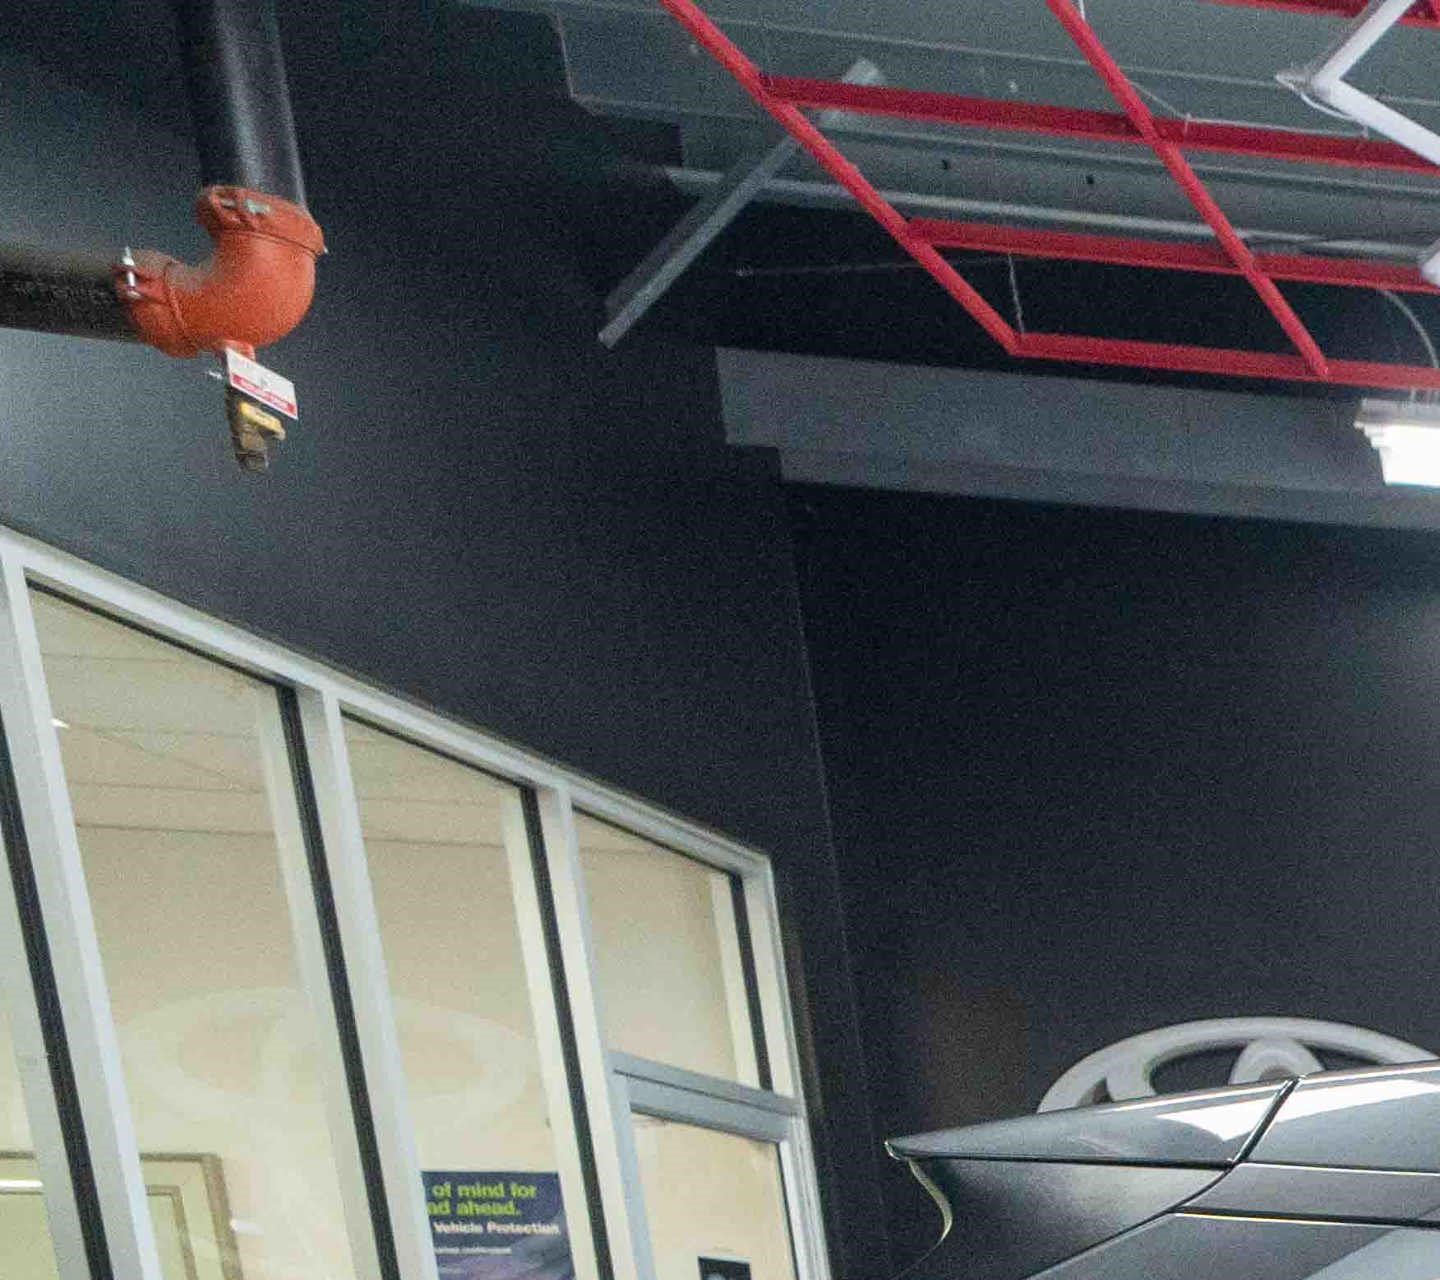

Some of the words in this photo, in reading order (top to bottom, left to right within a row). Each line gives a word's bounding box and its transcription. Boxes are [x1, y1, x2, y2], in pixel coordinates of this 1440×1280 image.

[432, 1182, 451, 1198] of
[457, 1182, 504, 1198] mind
[510, 1182, 537, 1198] for
[433, 1222, 483, 1235] Vehicle
[487, 1222, 560, 1236] Protection
